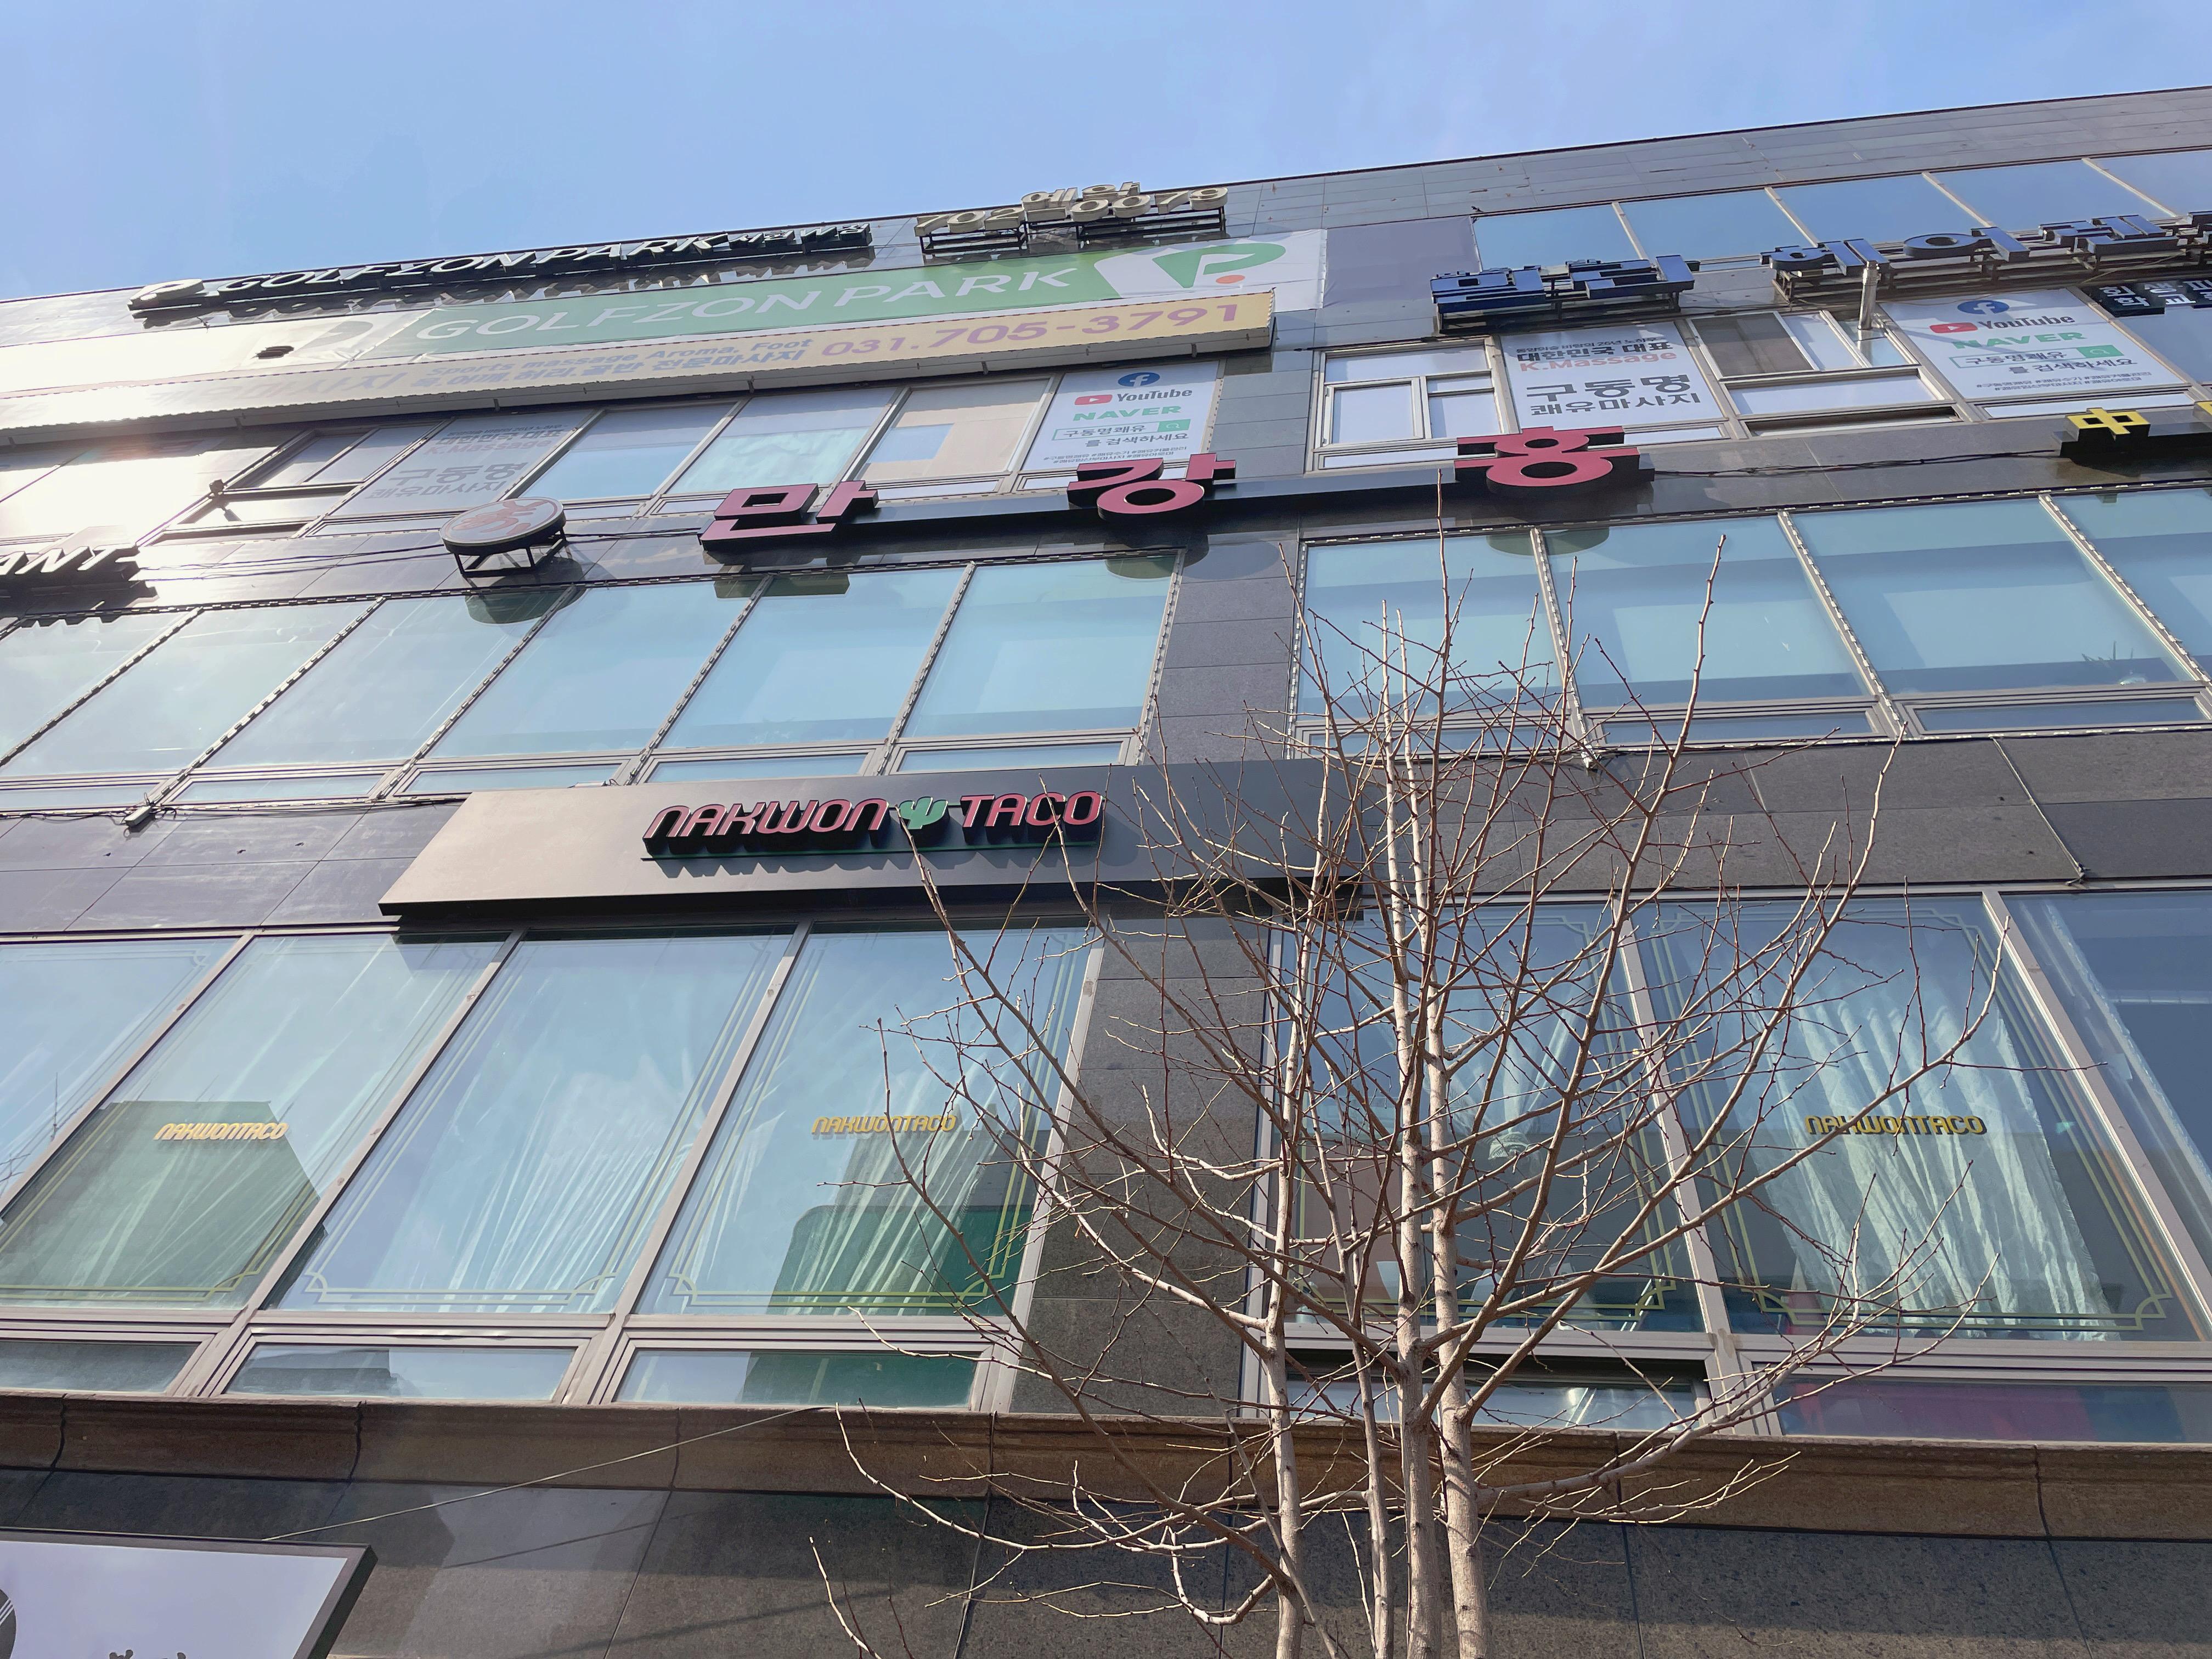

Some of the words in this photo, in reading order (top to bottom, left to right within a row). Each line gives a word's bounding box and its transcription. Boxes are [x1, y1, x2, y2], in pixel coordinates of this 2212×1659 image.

[217, 251, 537, 292] GOLFZON
[538, 232, 730, 266] PARK
[416, 291, 822, 340] GOLFZON
[833, 267, 1079, 307] PARK
[820, 304, 1239, 357] 031.705-3791
[1977, 315, 2076, 330] YouTube
[1951, 332, 2088, 349] NAVER
[426, 363, 516, 376] Sports
[523, 353, 639, 369] massage
[750, 338, 814, 351] Foot
[651, 349, 806, 371] 전문마사지
[1517, 346, 1615, 362] 대한민국
[1622, 342, 1673, 354] 대표
[1966, 351, 2067, 365] 구동명쾌유
[1520, 352, 1678, 372] K.Massage
[2033, 358, 2138, 373] 검색하세요
[1118, 389, 1192, 402] YouTube
[1526, 374, 1691, 402] 구동명
[1073, 405, 1181, 421] NAVER
[1530, 393, 1701, 416] 쾌유마사지
[436, 432, 514, 445] 대한민국
[517, 429, 566, 441] 대표
[1063, 425, 1146, 437] 구동명쾌유
[1106, 433, 1189, 445] 검색하세요
[389, 462, 529, 486] 구동명
[364, 481, 507, 499] 쾌유마사지
[644, 798, 890, 839] NAKWON
[960, 790, 1103, 828] TACO
[153, 1122, 290, 1141] NAKWONTACO
[811, 1114, 957, 1133] NAKWONTACO
[1804, 1115, 1988, 1135] NAKWONTACO
